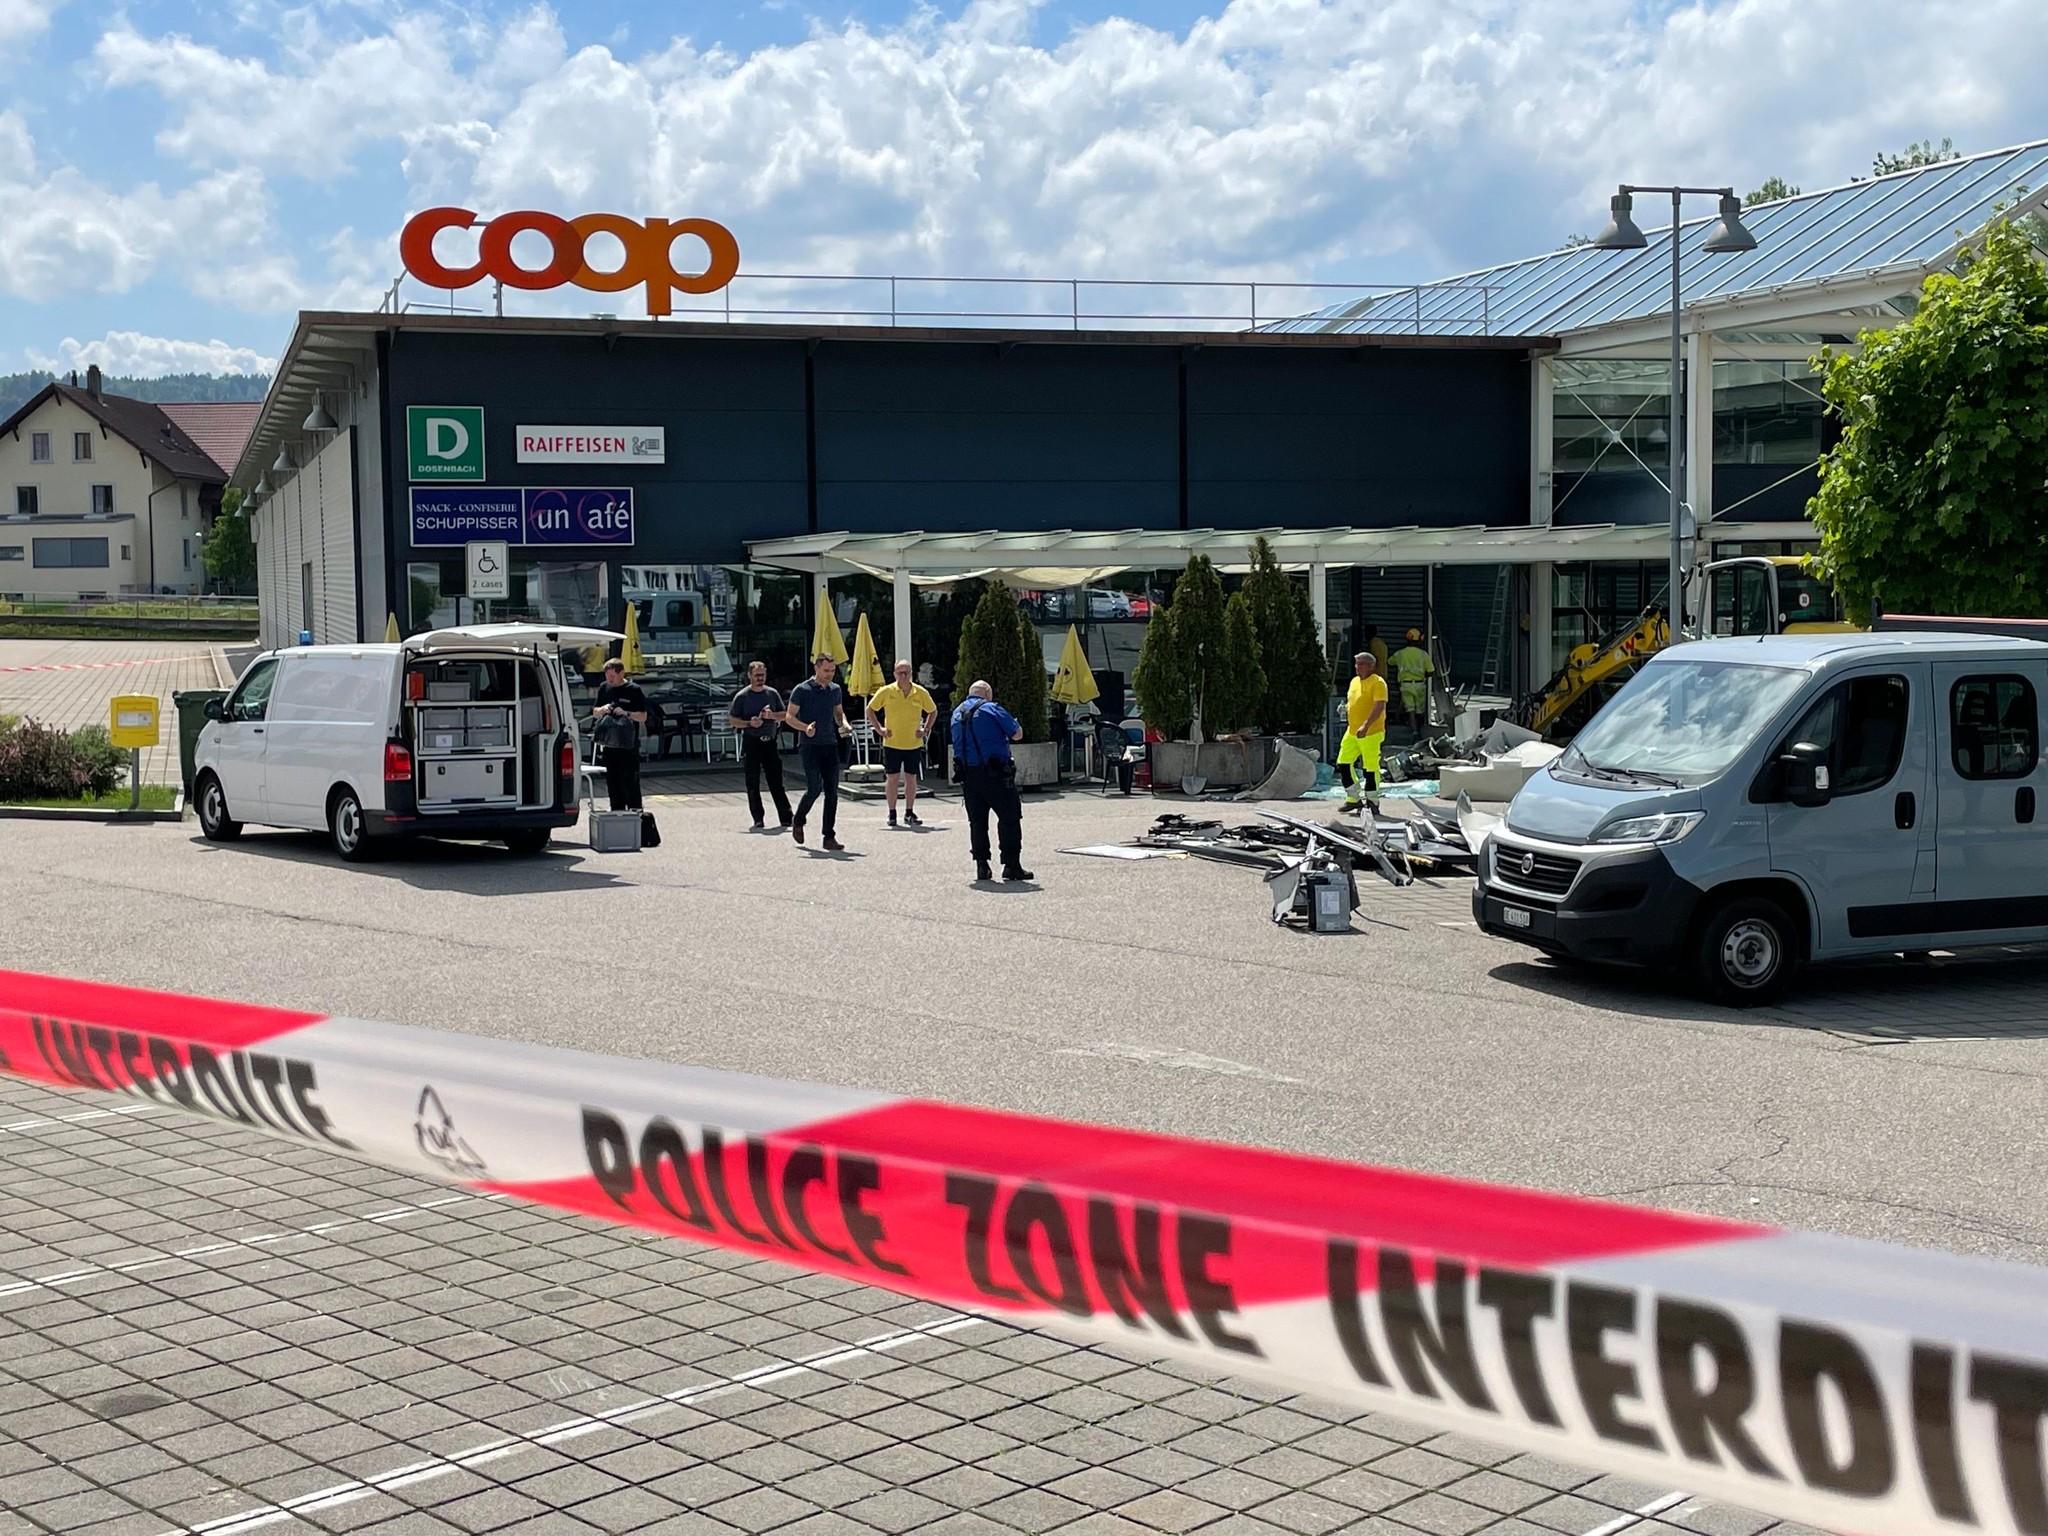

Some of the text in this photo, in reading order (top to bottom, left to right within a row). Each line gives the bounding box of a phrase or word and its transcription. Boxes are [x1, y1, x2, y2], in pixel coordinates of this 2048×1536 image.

[400, 206, 740, 315] coop
[426, 418, 469, 459] D
[523, 437, 625, 452] RAIFFEISEN
[418, 465, 476, 473] DOSENBACH
[416, 503, 451, 512] SNACK
[458, 503, 517, 513] CONFISERIE
[416, 517, 518, 529] SCHUPPISSER
[538, 508, 570, 529] un
[472, 580, 503, 588] 2 cases
[30, 1014, 368, 1151] INTERDITE
[580, 1103, 916, 1276] POLICE
[945, 1171, 1270, 1360] ZONE
